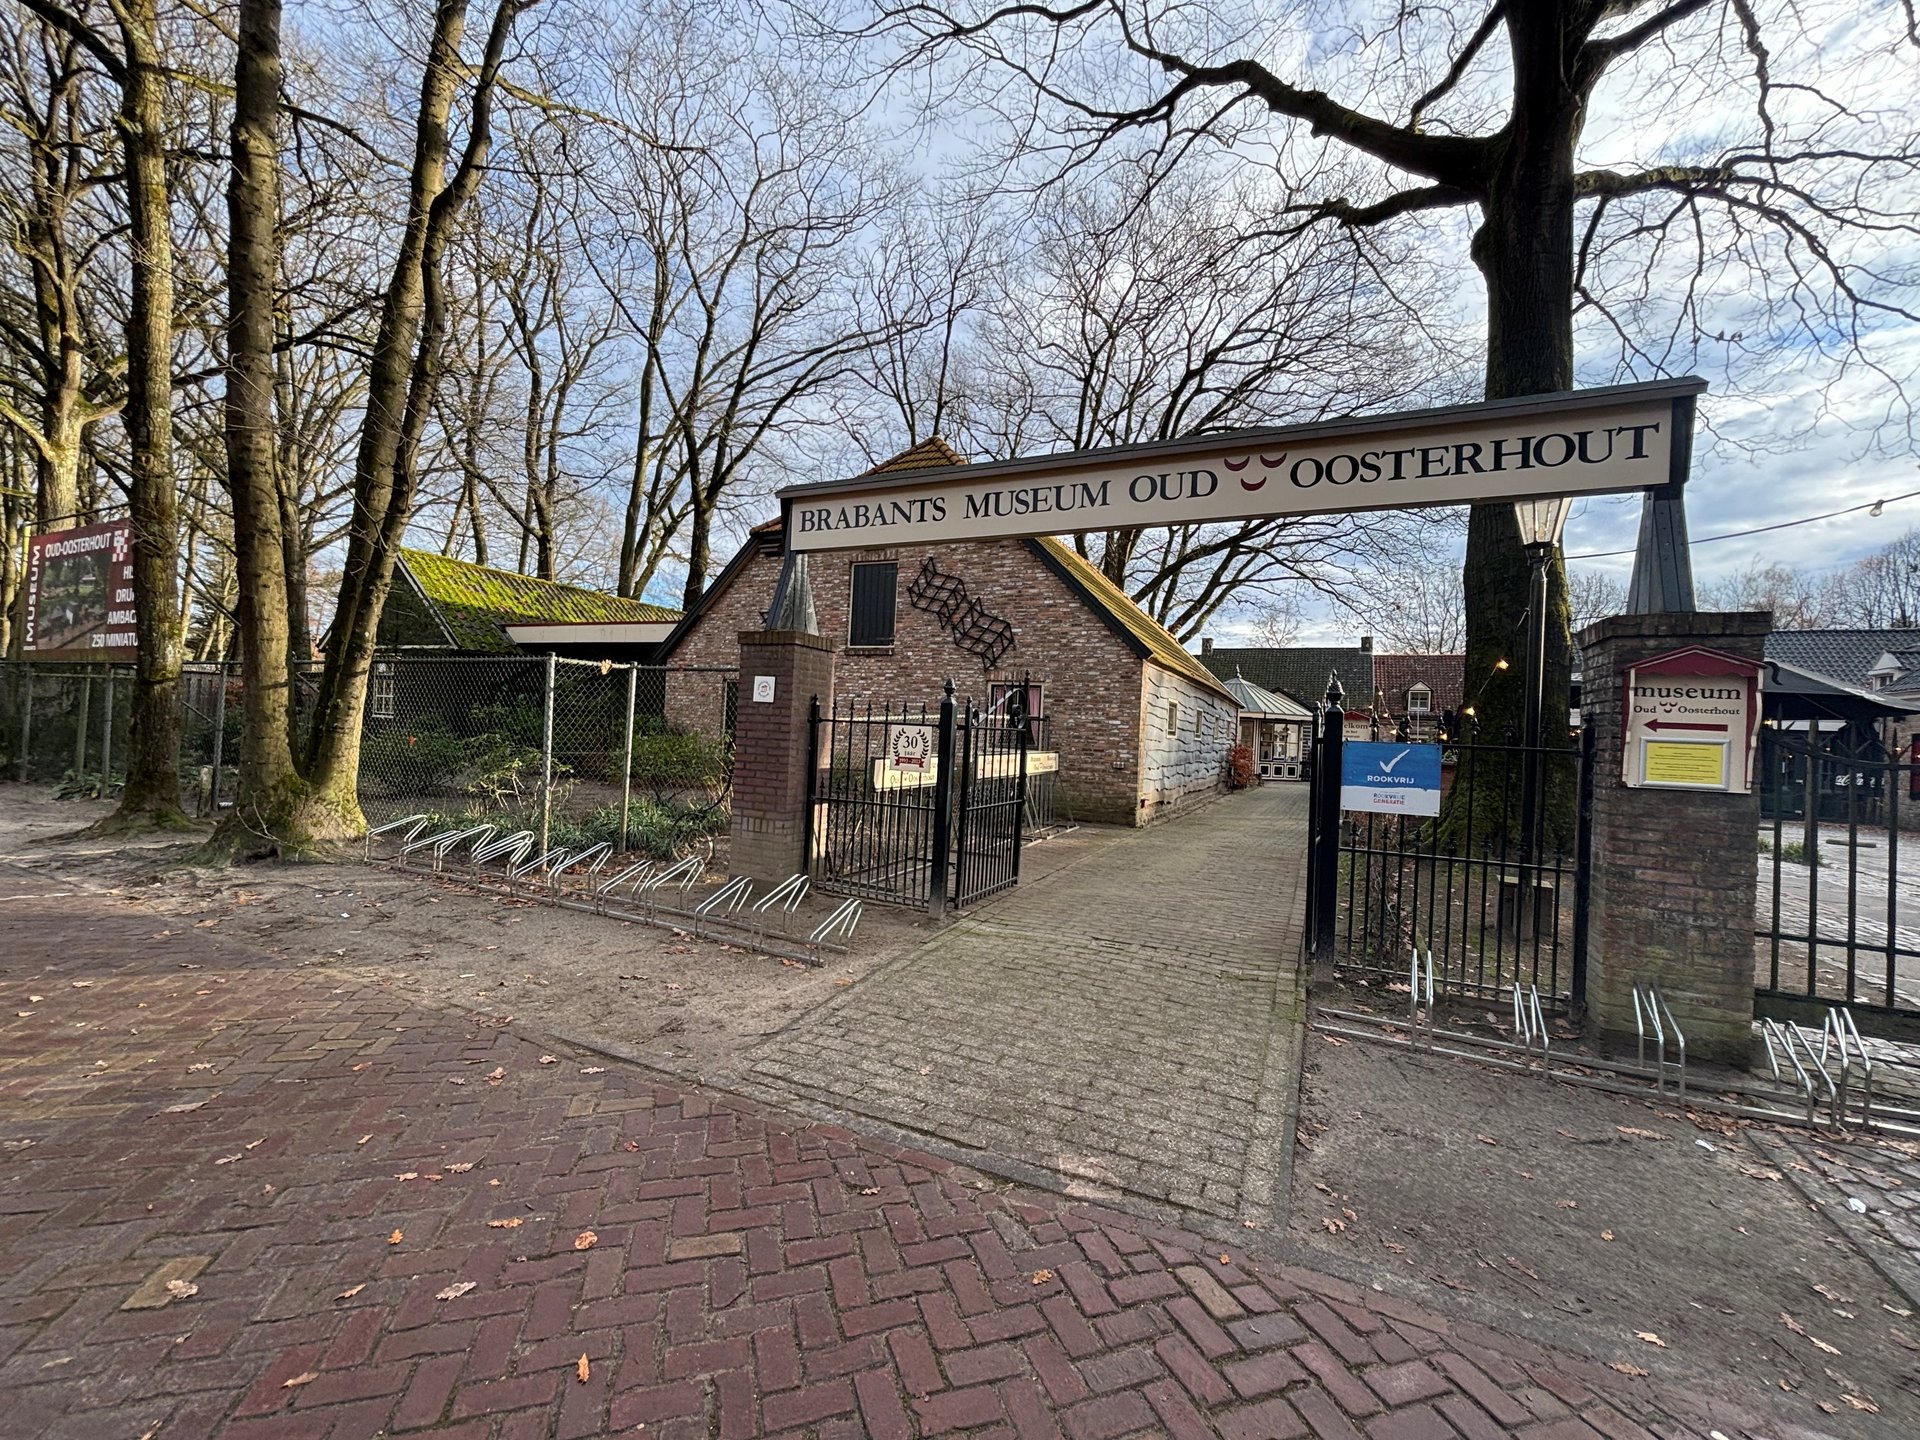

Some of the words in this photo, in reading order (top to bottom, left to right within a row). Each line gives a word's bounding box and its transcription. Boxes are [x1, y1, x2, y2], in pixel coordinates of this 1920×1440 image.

[799, 497, 946, 533] BRABANTS
[963, 480, 1111, 519] MUSEUM
[1128, 469, 1218, 502] OUD
[1290, 422, 1660, 489] OOSTERHOUT
[45, 533, 111, 558] OUD-OOSTERHOUT
[25, 545, 40, 642] MUSEUM
[92, 633, 105, 647] 250
[1629, 686, 1742, 700] museum
[1633, 705, 1656, 714] Oud
[1677, 705, 1740, 715] Oosterhout
[1343, 722, 1368, 730] elkom
[902, 735, 918, 749] 30
[1367, 775, 1414, 784] ROOKVRIJ
